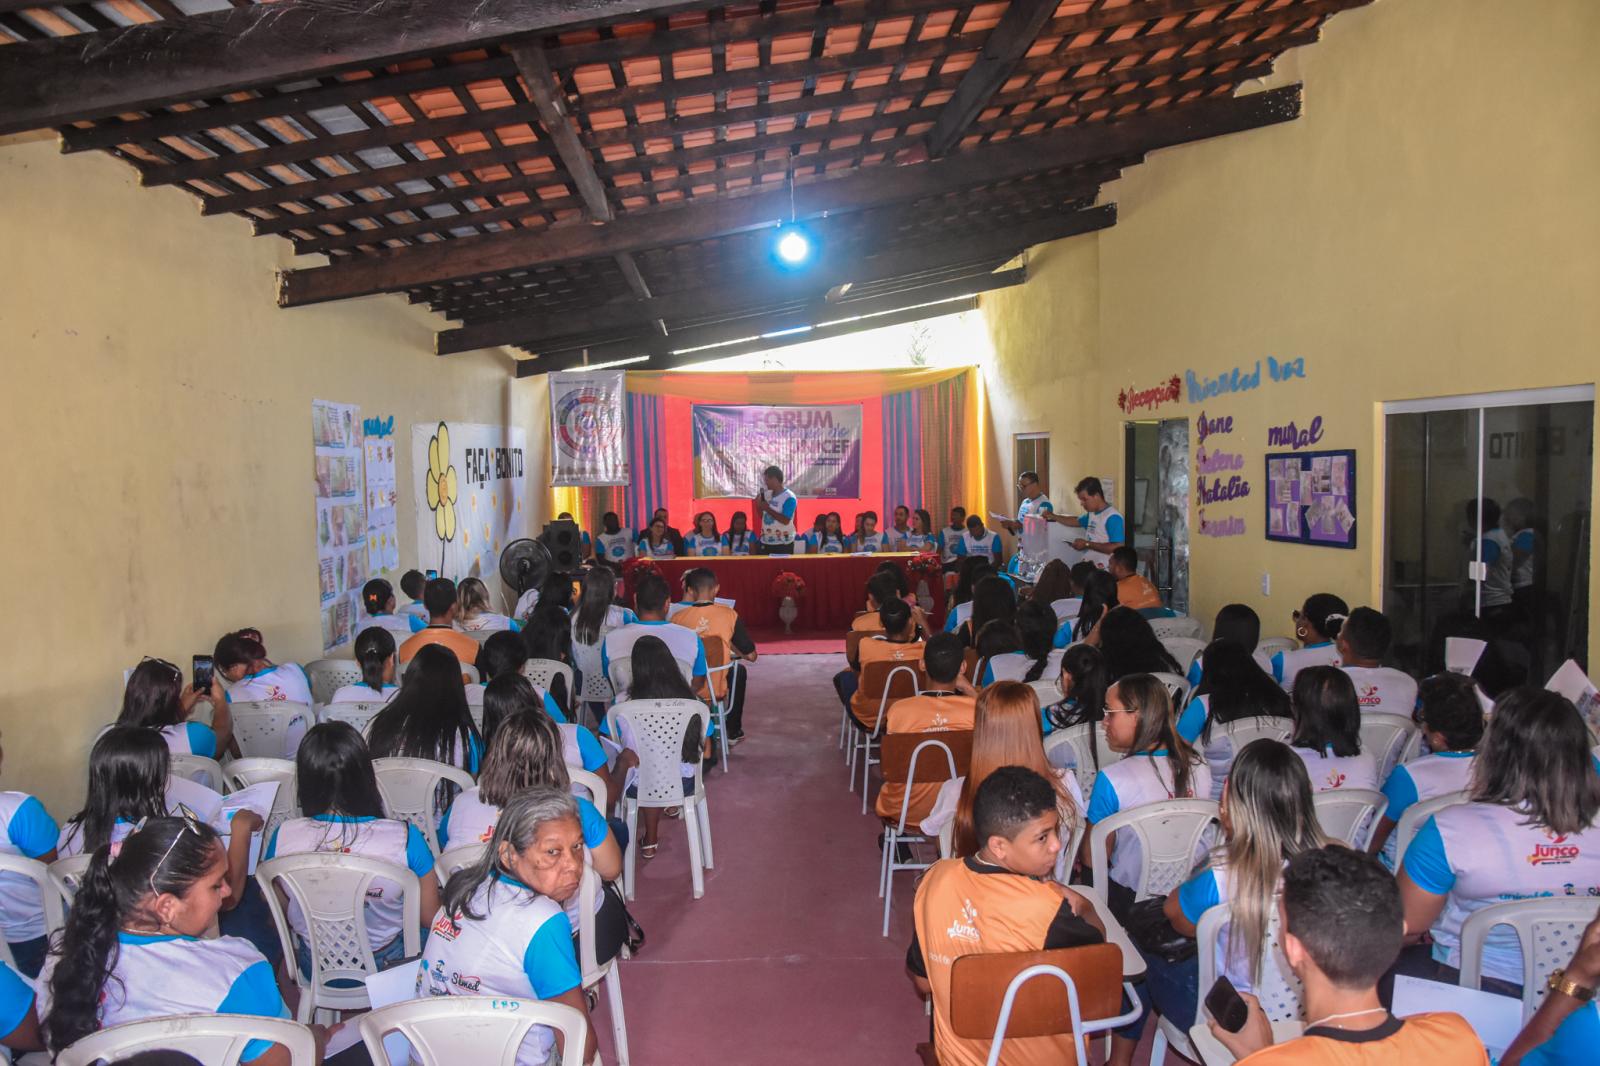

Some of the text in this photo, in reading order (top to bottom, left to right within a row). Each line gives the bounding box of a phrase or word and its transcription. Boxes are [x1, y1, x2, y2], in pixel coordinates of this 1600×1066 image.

[465, 447, 523, 489] FAÇA BONITO
[1359, 696, 1382, 704] unco
[1532, 844, 1580, 857] Junco
